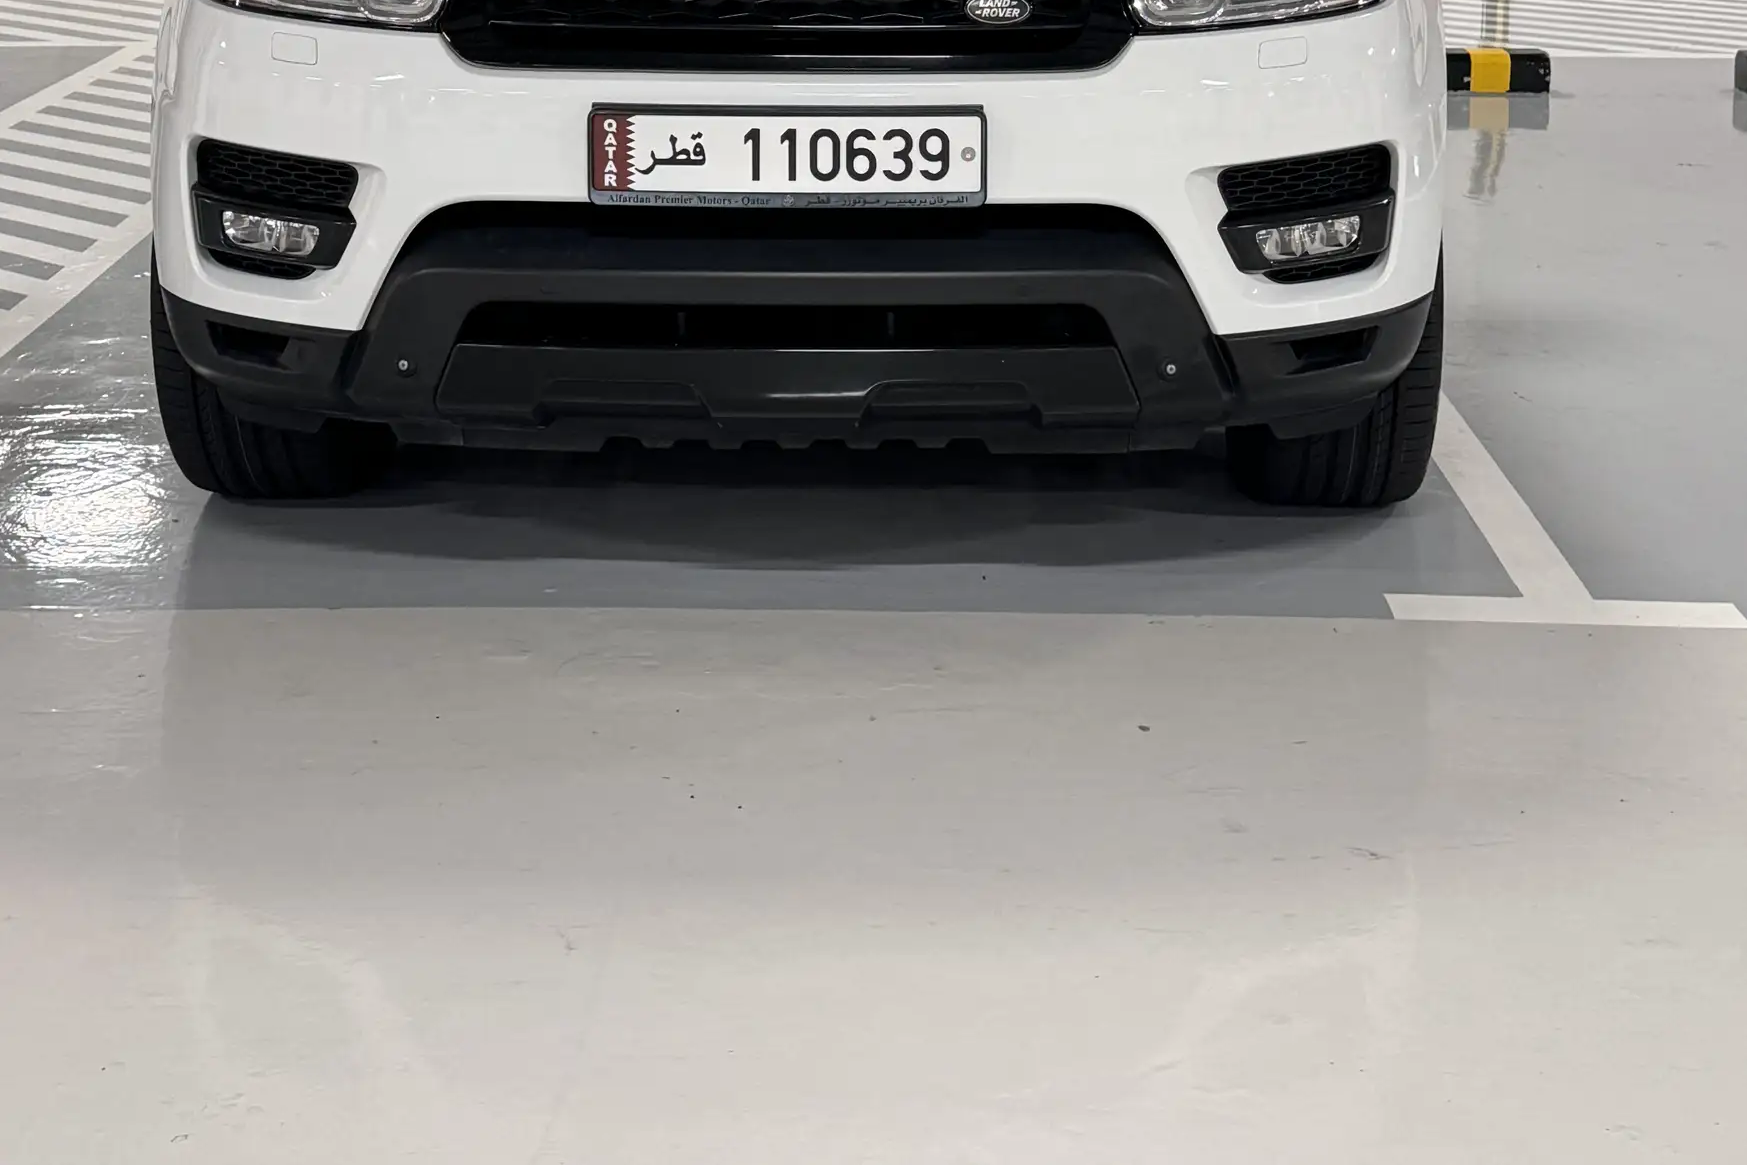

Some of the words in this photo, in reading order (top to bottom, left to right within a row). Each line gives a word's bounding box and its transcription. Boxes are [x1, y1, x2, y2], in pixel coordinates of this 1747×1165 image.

[982, 7, 1021, 18] ROVER
[603, 118, 618, 187] QATAR
[635, 131, 707, 175] قطر
[743, 127, 950, 182] 110639
[607, 194, 651, 204] Alfardan
[654, 195, 694, 204] Premier
[696, 196, 732, 205] Motors
[741, 196, 771, 206] Qatar
